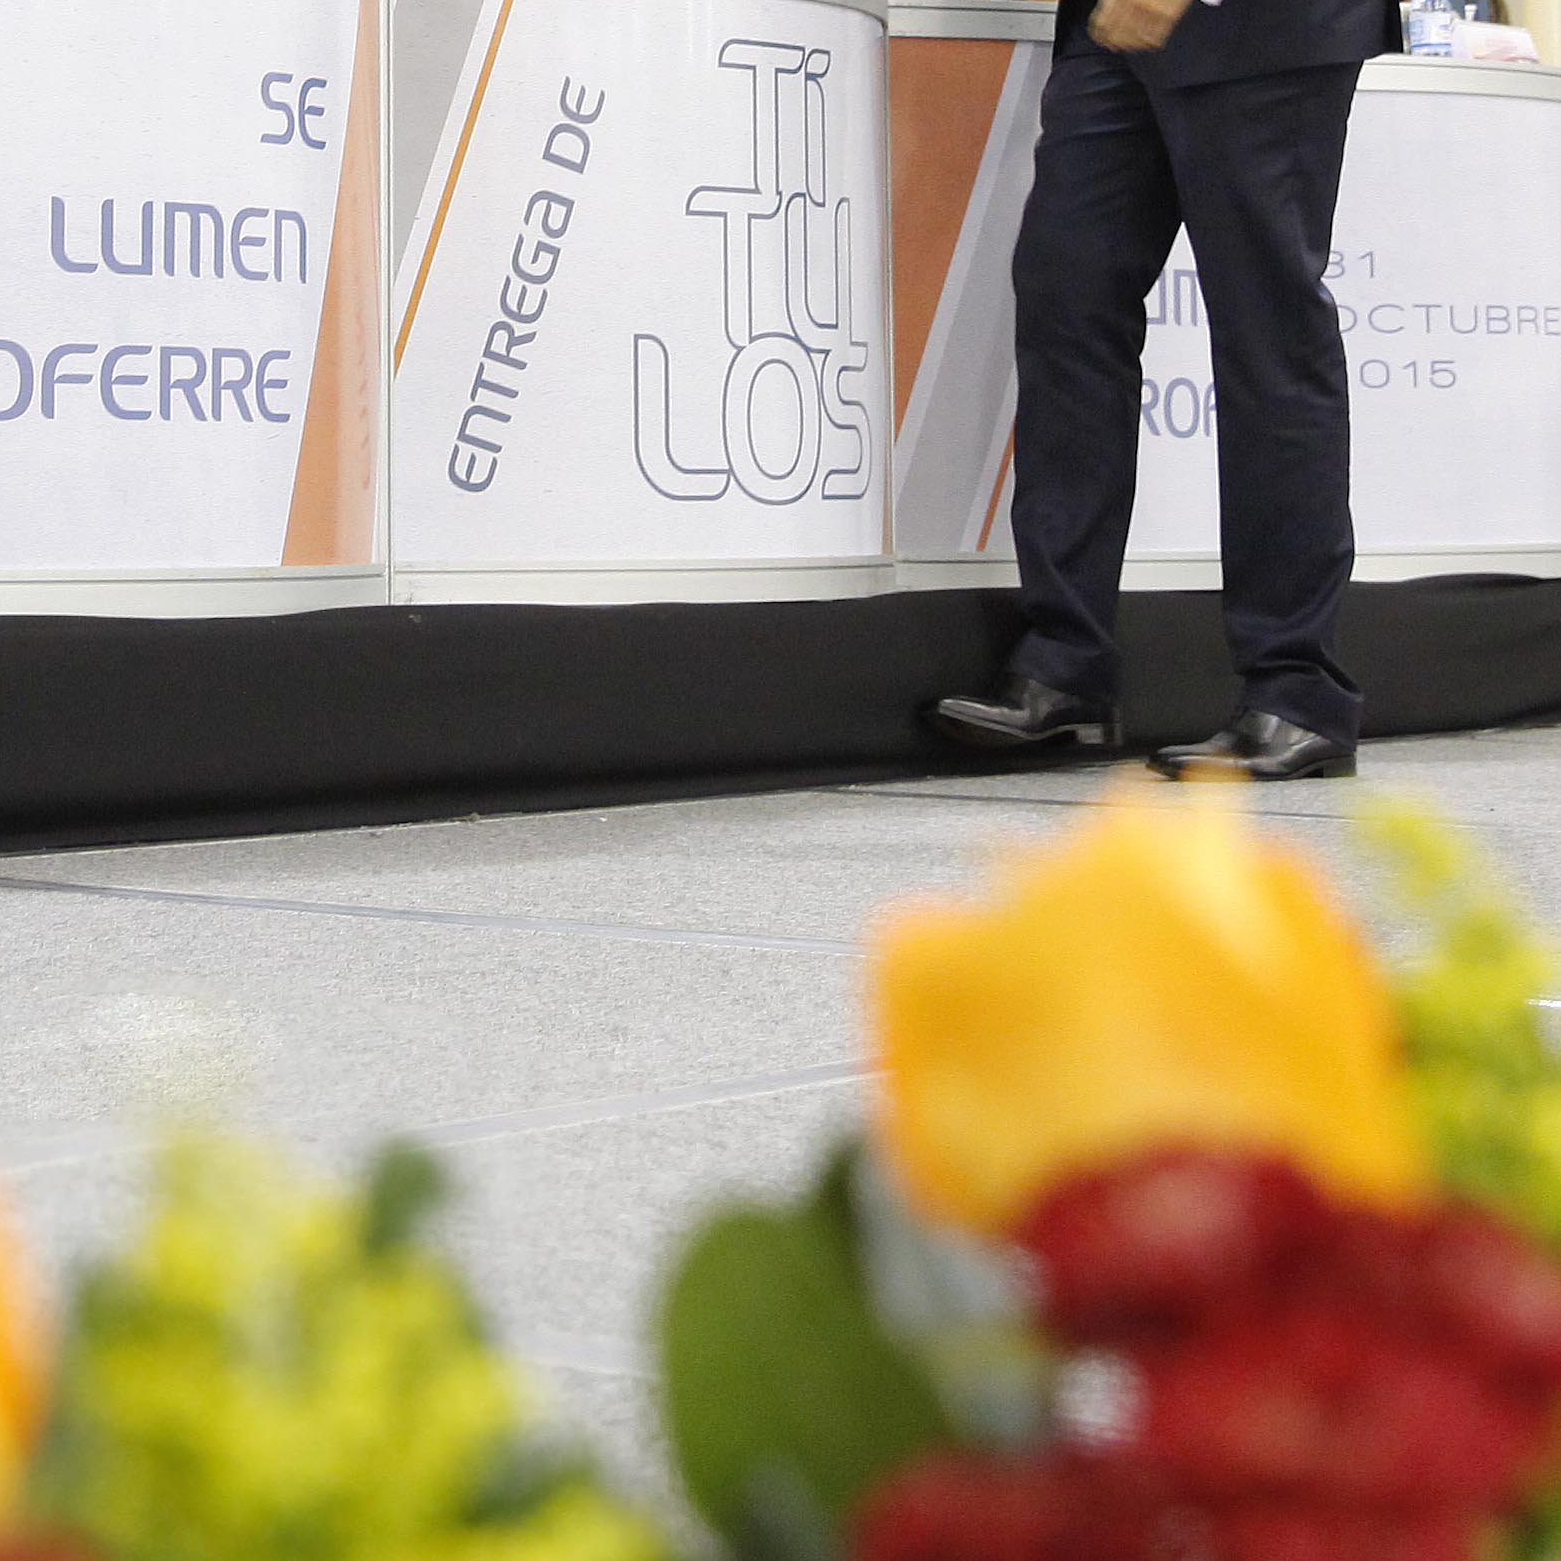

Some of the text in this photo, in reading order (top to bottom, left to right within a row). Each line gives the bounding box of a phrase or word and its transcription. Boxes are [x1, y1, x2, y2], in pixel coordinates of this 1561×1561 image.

[260, 71, 328, 150] SE
[541, 76, 606, 174] DE
[1359, 359, 1457, 389] 015
